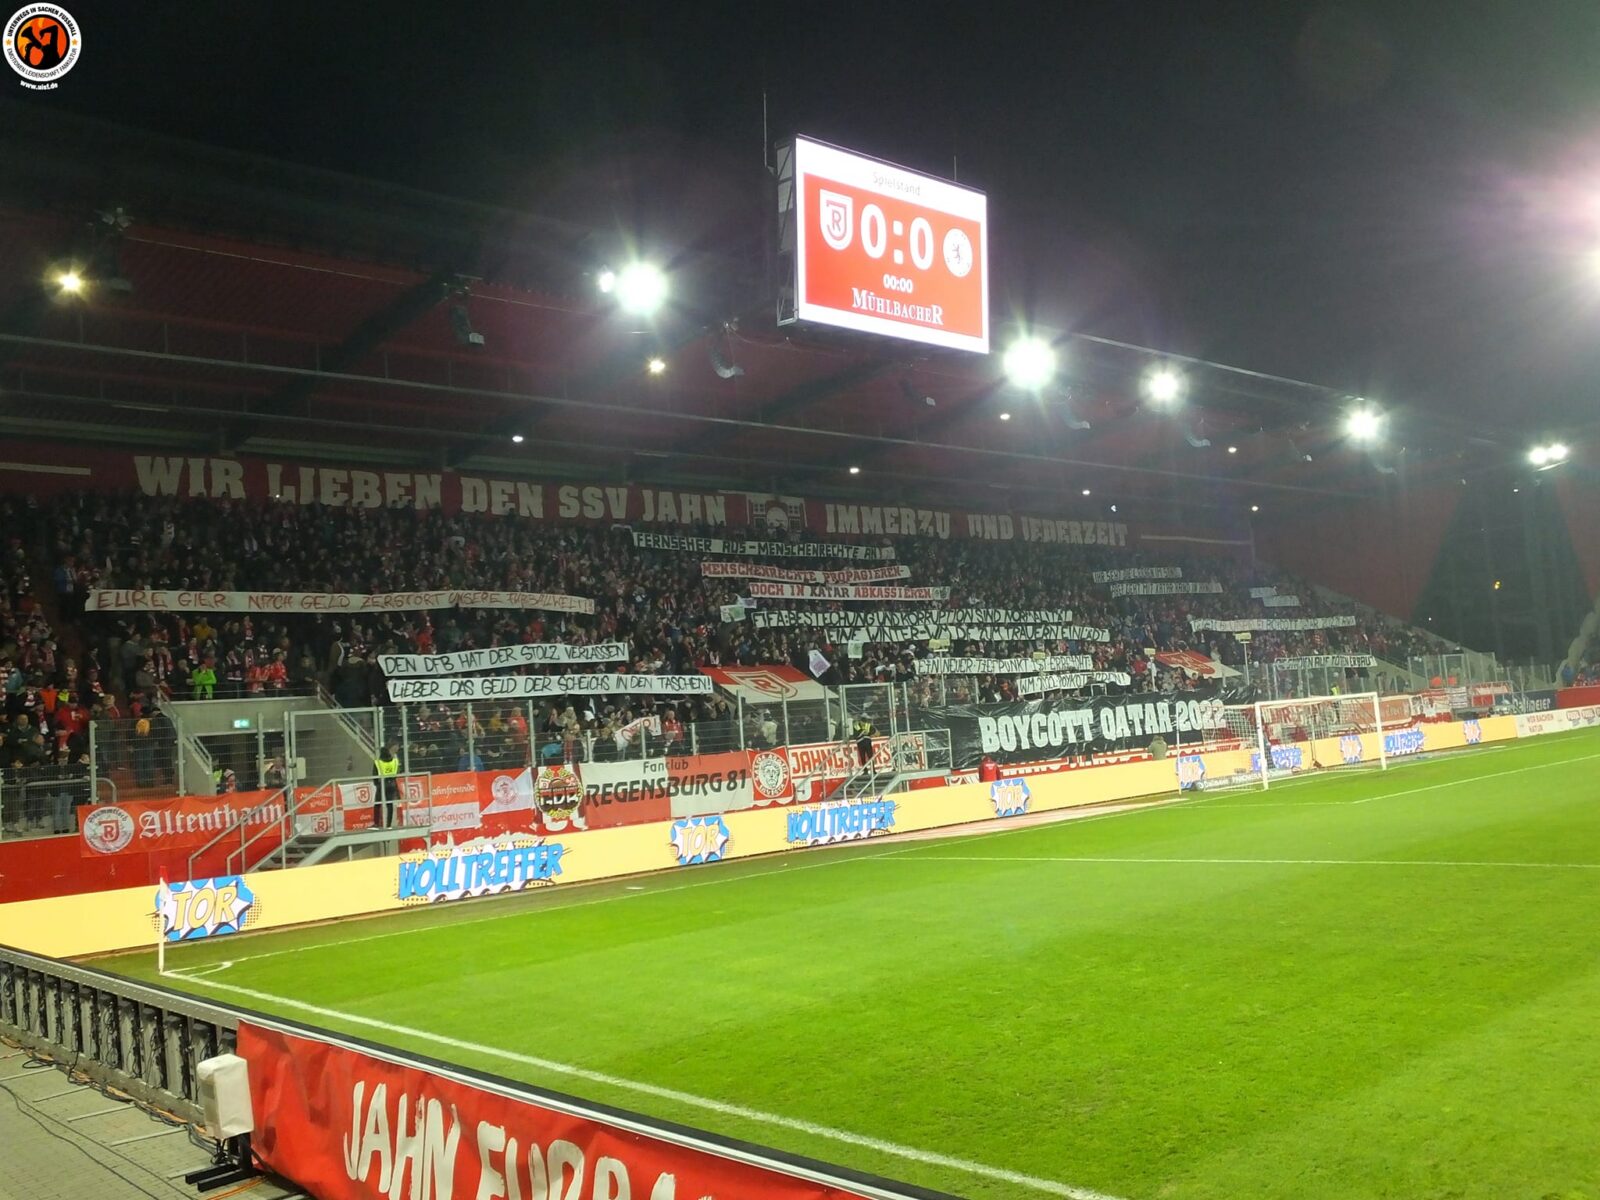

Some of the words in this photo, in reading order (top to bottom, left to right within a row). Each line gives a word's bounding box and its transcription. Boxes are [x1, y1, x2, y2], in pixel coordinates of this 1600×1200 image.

[873, 172, 921, 196] Spielstand
[883, 273, 914, 293] 00:00
[133, 456, 246, 499] WIR
[267, 463, 442, 509] LIEBEN
[460, 476, 544, 518] DEN
[558, 486, 629, 519] SSV
[641, 489, 727, 526] JAHN
[825, 504, 950, 539] IMMERZU
[967, 514, 1014, 540] UND
[637, 533, 712, 552] FERNSEHER
[702, 562, 817, 582] MENSCHENRECHTE
[97, 590, 168, 608] EURE
[178, 592, 227, 608] GIER
[300, 594, 350, 610] GELD
[751, 583, 784, 596] DOCH
[791, 585, 805, 596] IN
[810, 586, 850, 598] KATAR
[385, 656, 417, 674] DEN
[424, 655, 454, 673] DFB
[458, 651, 485, 669] HAT
[489, 647, 517, 665] DER
[520, 645, 560, 661] STOLZ
[450, 679, 474, 696] DAS
[481, 678, 517, 695] GELD
[524, 676, 552, 693] DER
[616, 676, 628, 690] IN
[630, 676, 653, 689] DEN
[657, 675, 711, 691] TASCHEN!
[978, 708, 1095, 754] BOYCOTT
[1100, 701, 1173, 741] QATAR
[1176, 699, 1227, 732] 2022
[643, 759, 689, 774] Fanclub
[585, 773, 722, 808] REGENSBURG
[726, 769, 747, 791] 81
[786, 799, 896, 843] VOLLTREFFER
[679, 824, 721, 856] TOR
[399, 843, 564, 900] VOLLTREFFER
[172, 886, 238, 931] TOR
[343, 1080, 461, 1200] JAHN
